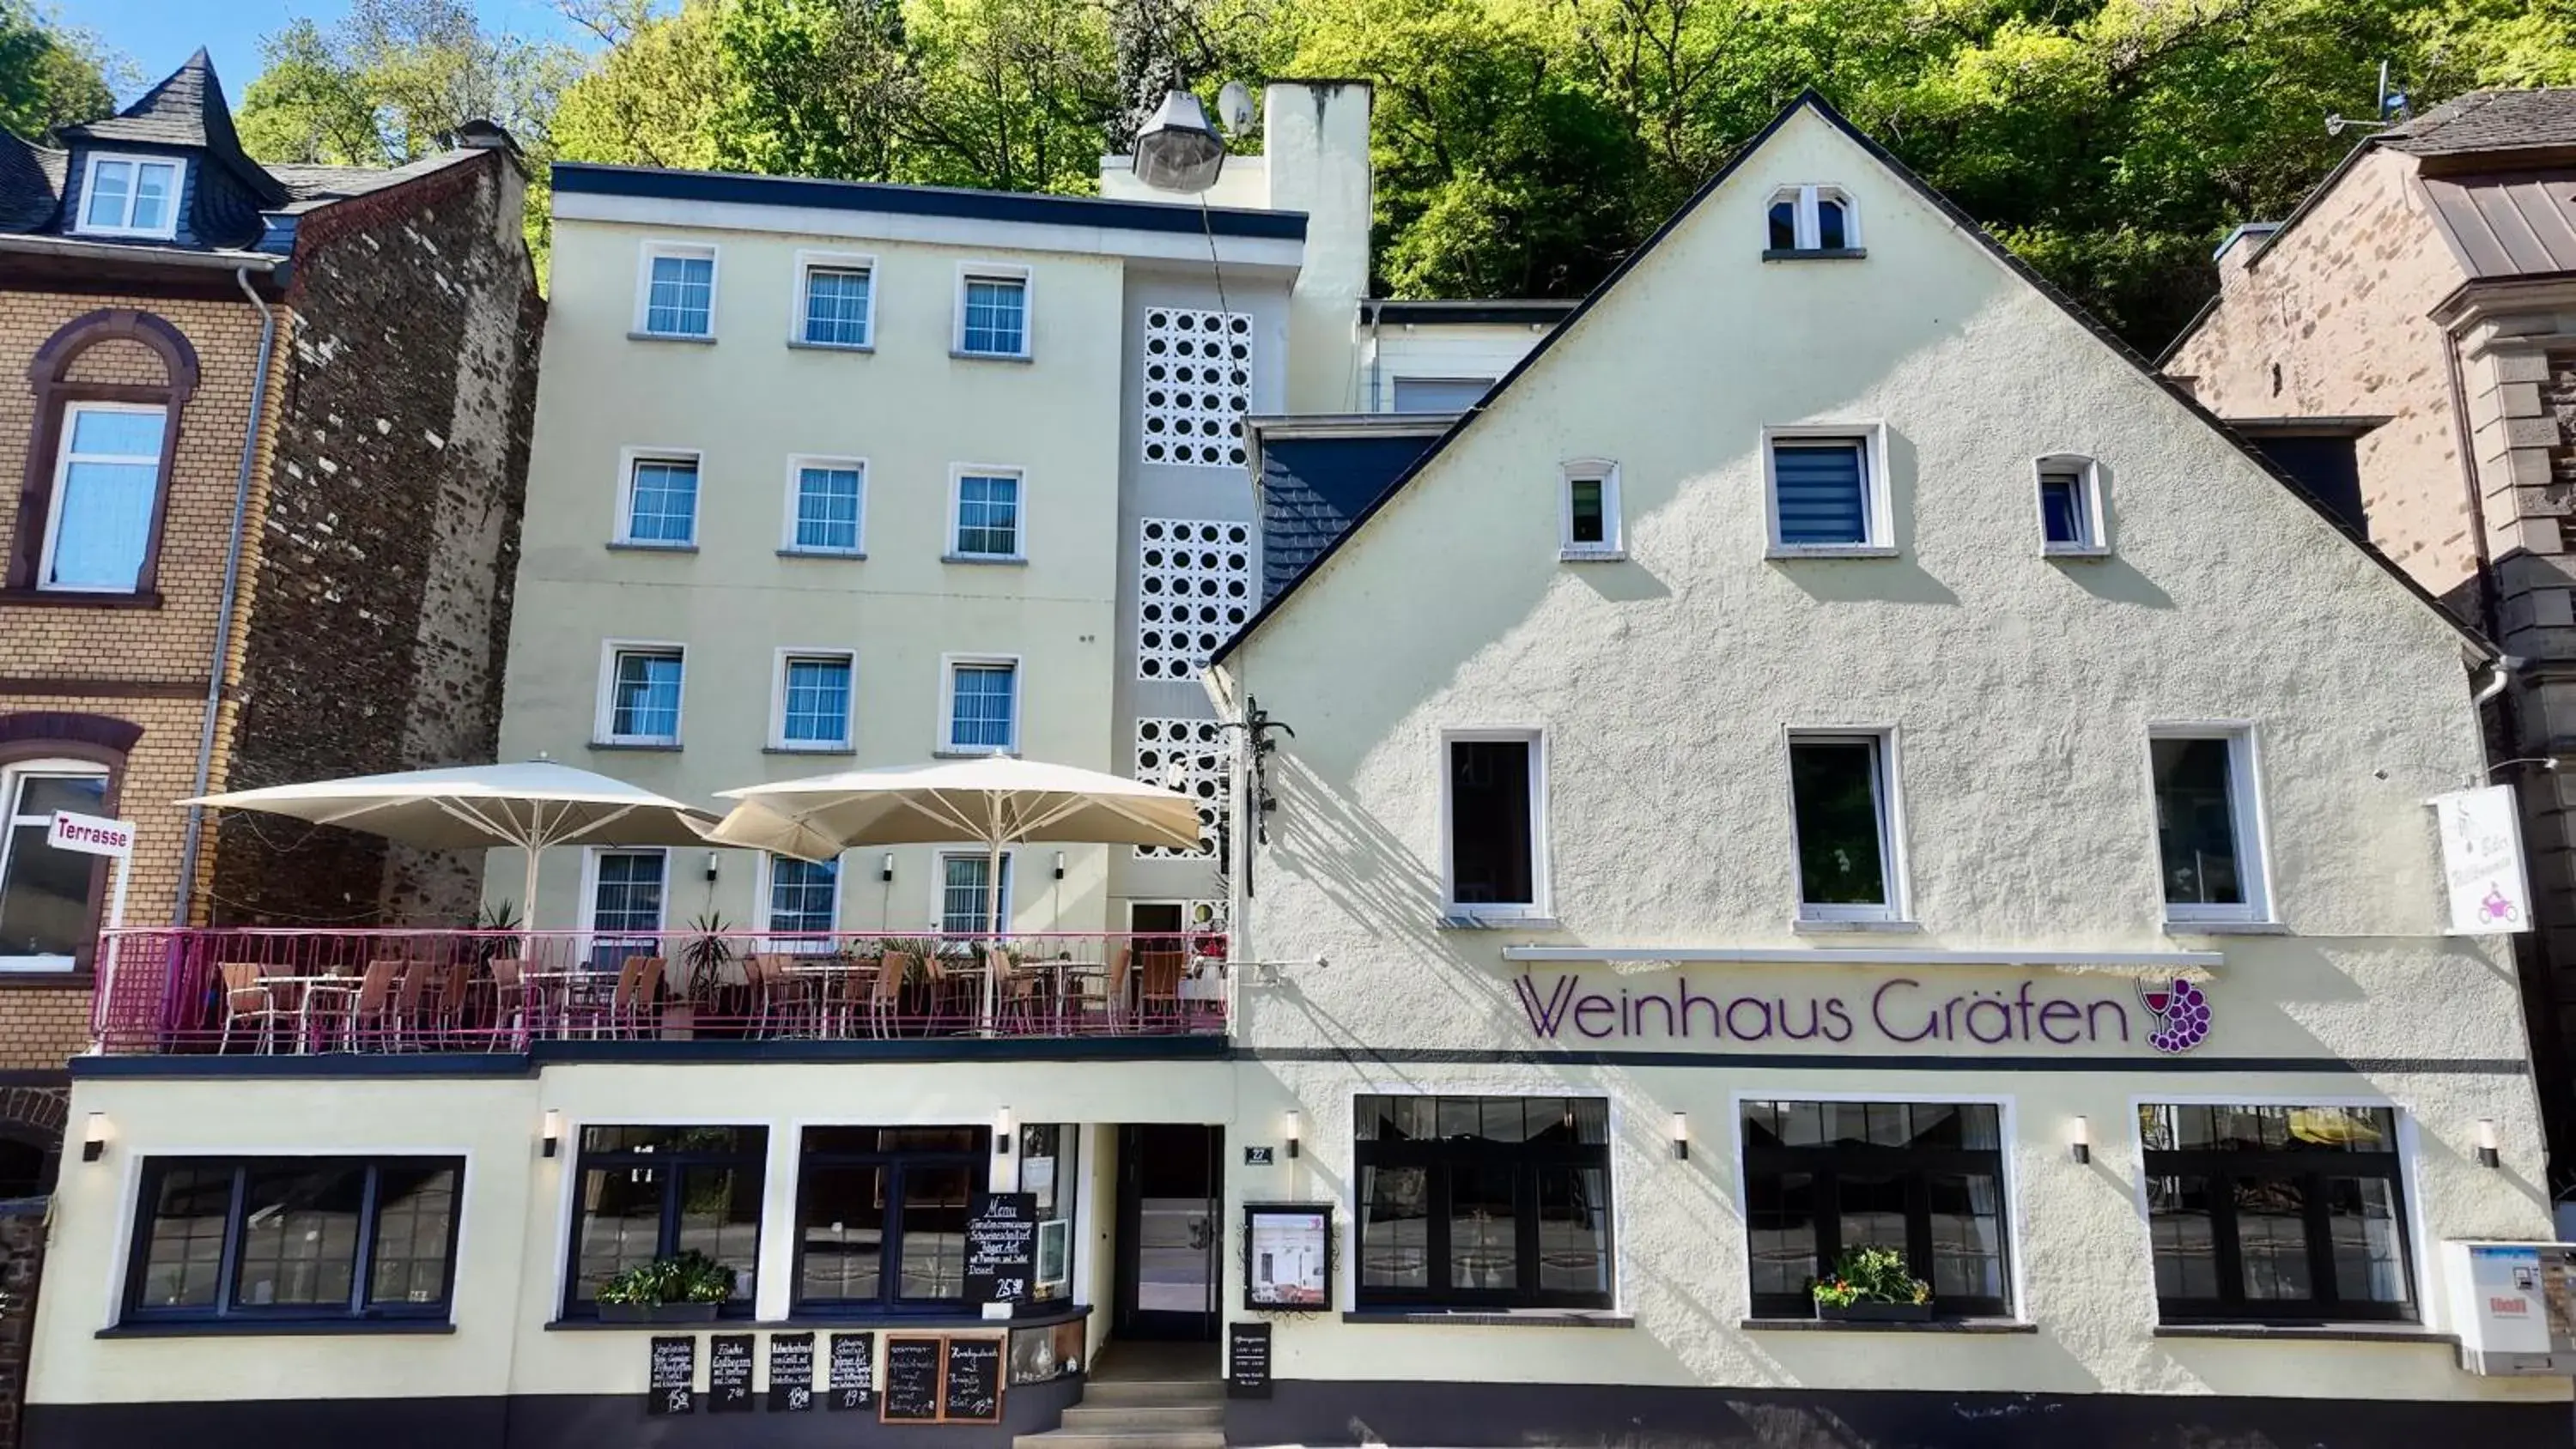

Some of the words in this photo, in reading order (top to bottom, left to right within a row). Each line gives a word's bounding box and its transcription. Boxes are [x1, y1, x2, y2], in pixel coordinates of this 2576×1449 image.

[58, 817, 128, 847] Terrasse
[1513, 974, 1854, 1042] Weinhaus
[1872, 977, 2129, 1044] Gräfen
